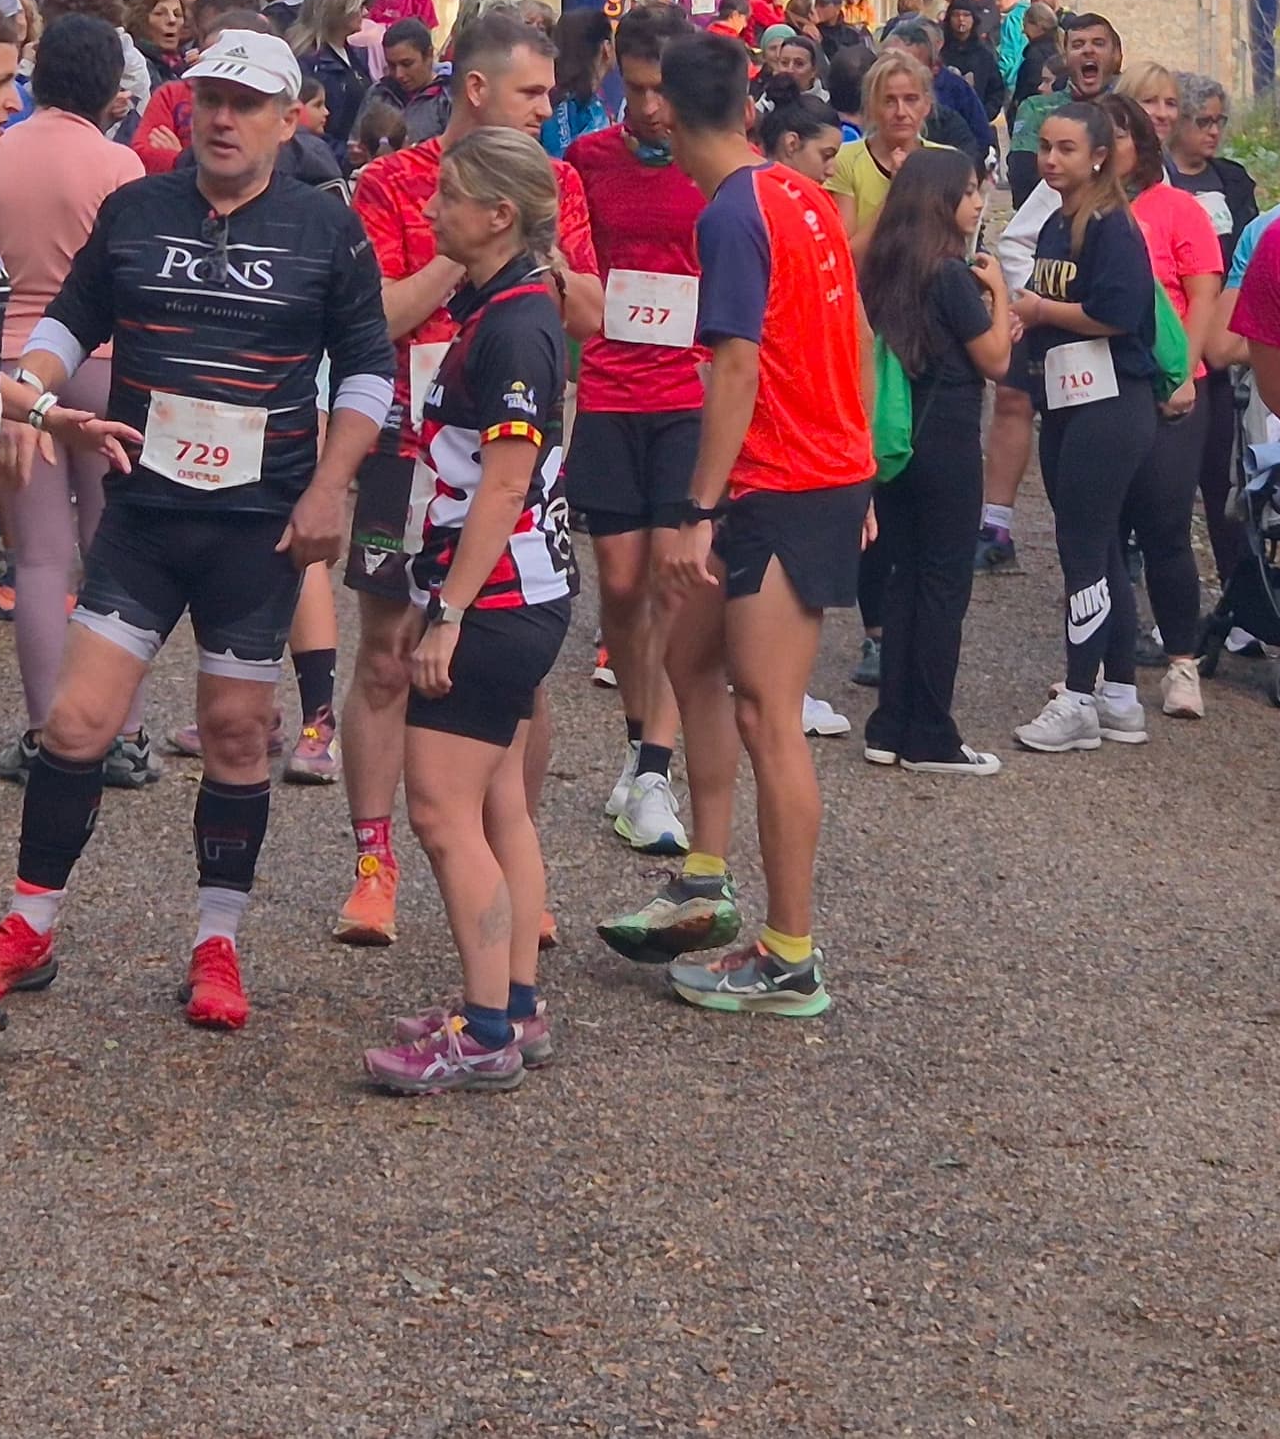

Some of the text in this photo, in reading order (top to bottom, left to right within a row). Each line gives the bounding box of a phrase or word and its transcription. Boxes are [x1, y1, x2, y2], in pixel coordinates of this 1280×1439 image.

[627, 304, 671, 325] 737
[1059, 370, 1095, 390] 710
[176, 439, 231, 468] 729
[177, 469, 224, 484] OSCAR
[1070, 577, 1109, 623] NIKE
